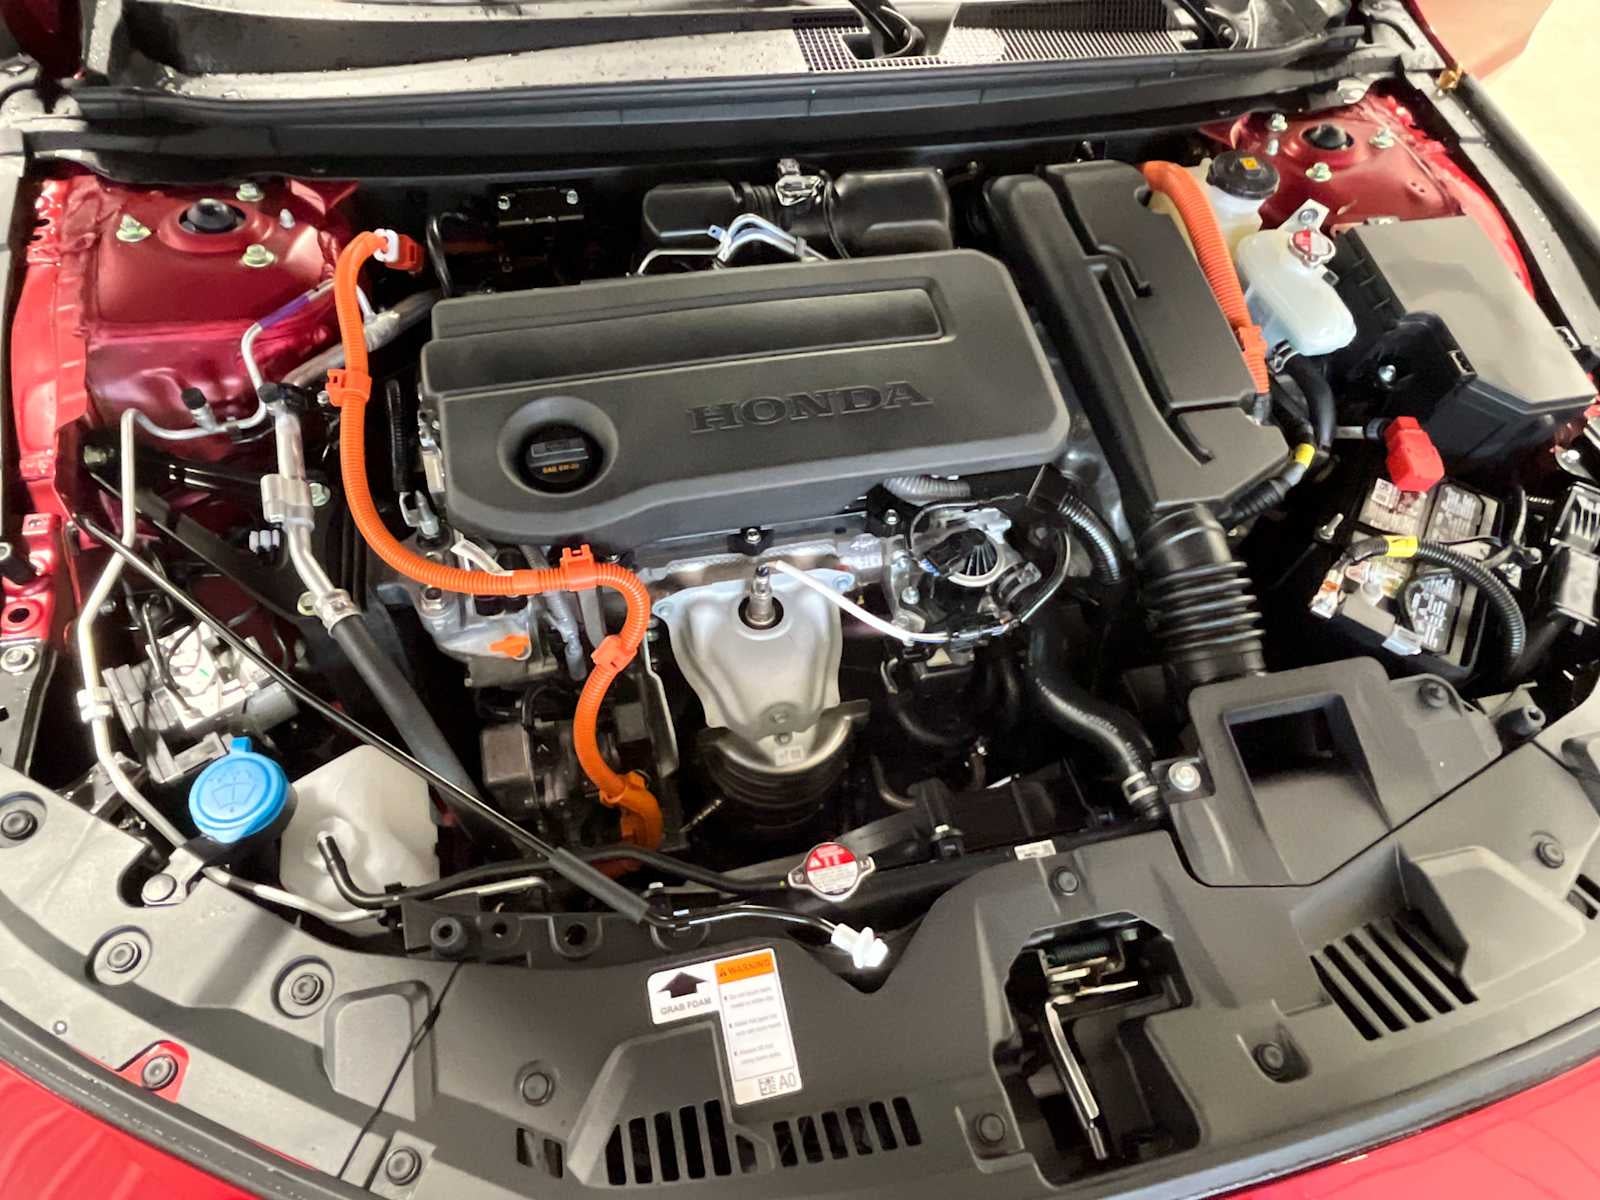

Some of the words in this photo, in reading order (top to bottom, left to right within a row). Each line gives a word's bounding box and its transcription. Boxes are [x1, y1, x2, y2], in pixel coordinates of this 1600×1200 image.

[687, 381, 934, 433] HONDA
[729, 958, 771, 975] WARNING
[660, 1001, 687, 1015] GRAB
[687, 997, 712, 1010] FOAM
